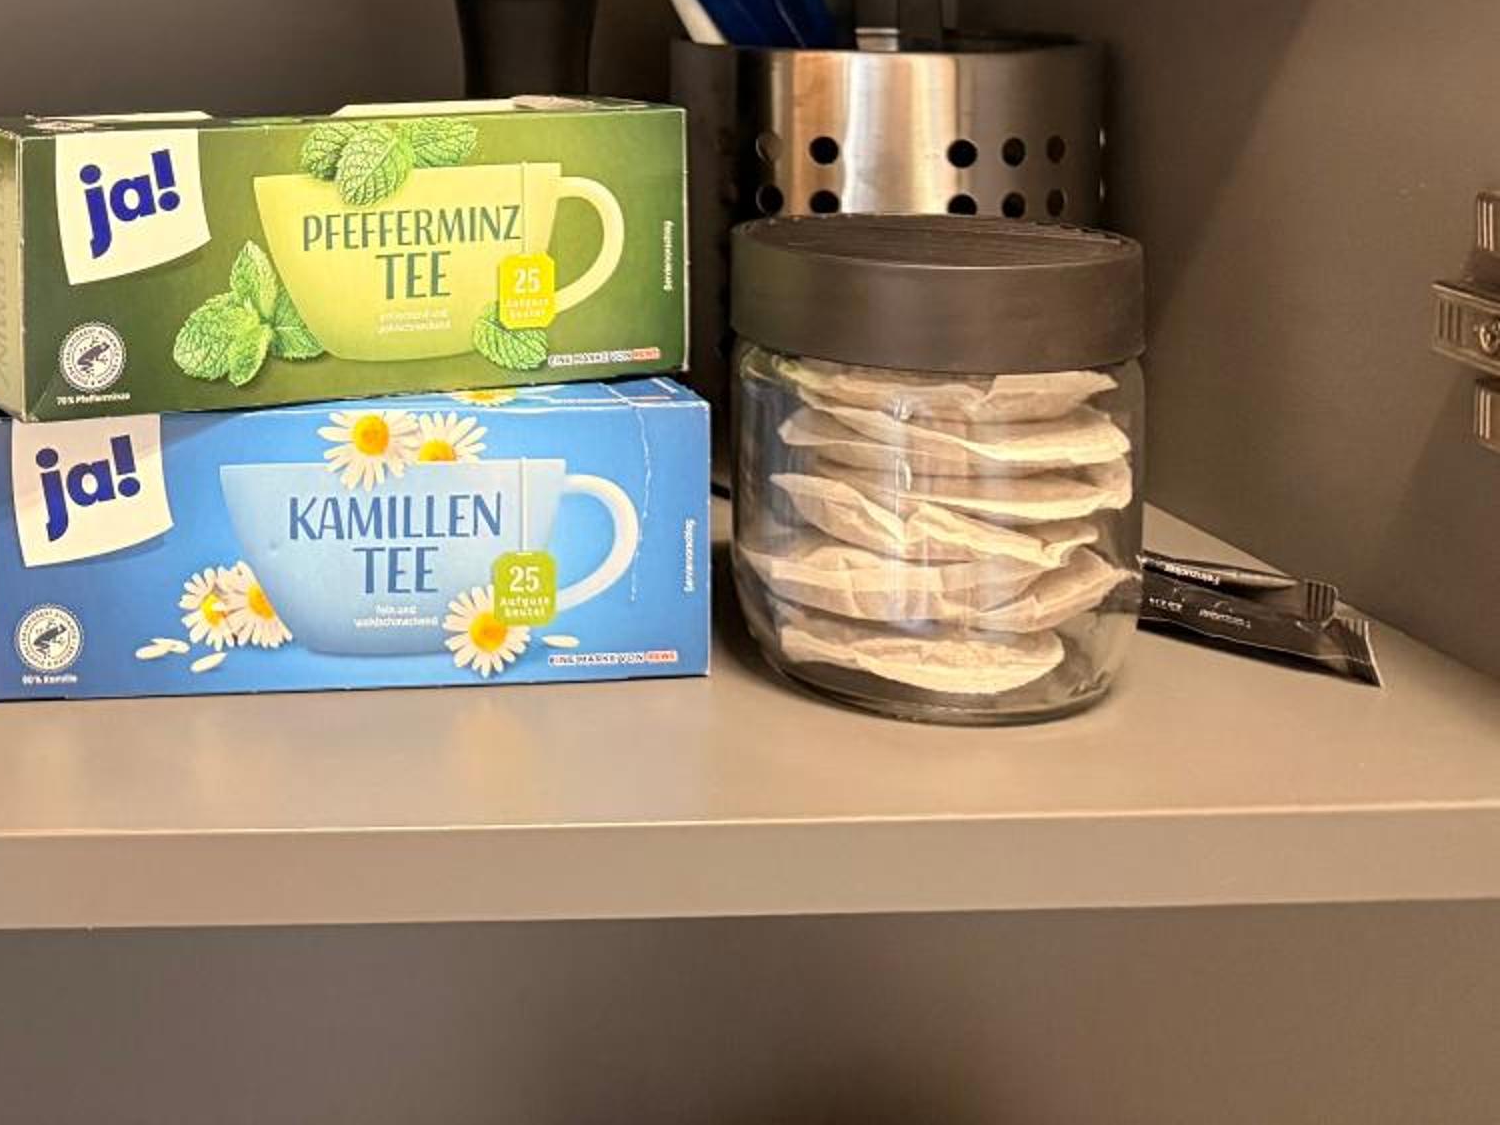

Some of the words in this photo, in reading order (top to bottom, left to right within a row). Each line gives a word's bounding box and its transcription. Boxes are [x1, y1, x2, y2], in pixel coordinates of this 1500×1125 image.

[79, 149, 181, 259] ja!
[303, 204, 521, 252] PFEFFERMINZ
[375, 250, 452, 300] TEE
[515, 266, 541, 294] 25
[35, 434, 142, 542] ja!
[289, 491, 501, 540] KAMILLEN
[353, 546, 439, 594] TEE
[509, 565, 540, 593] 25
